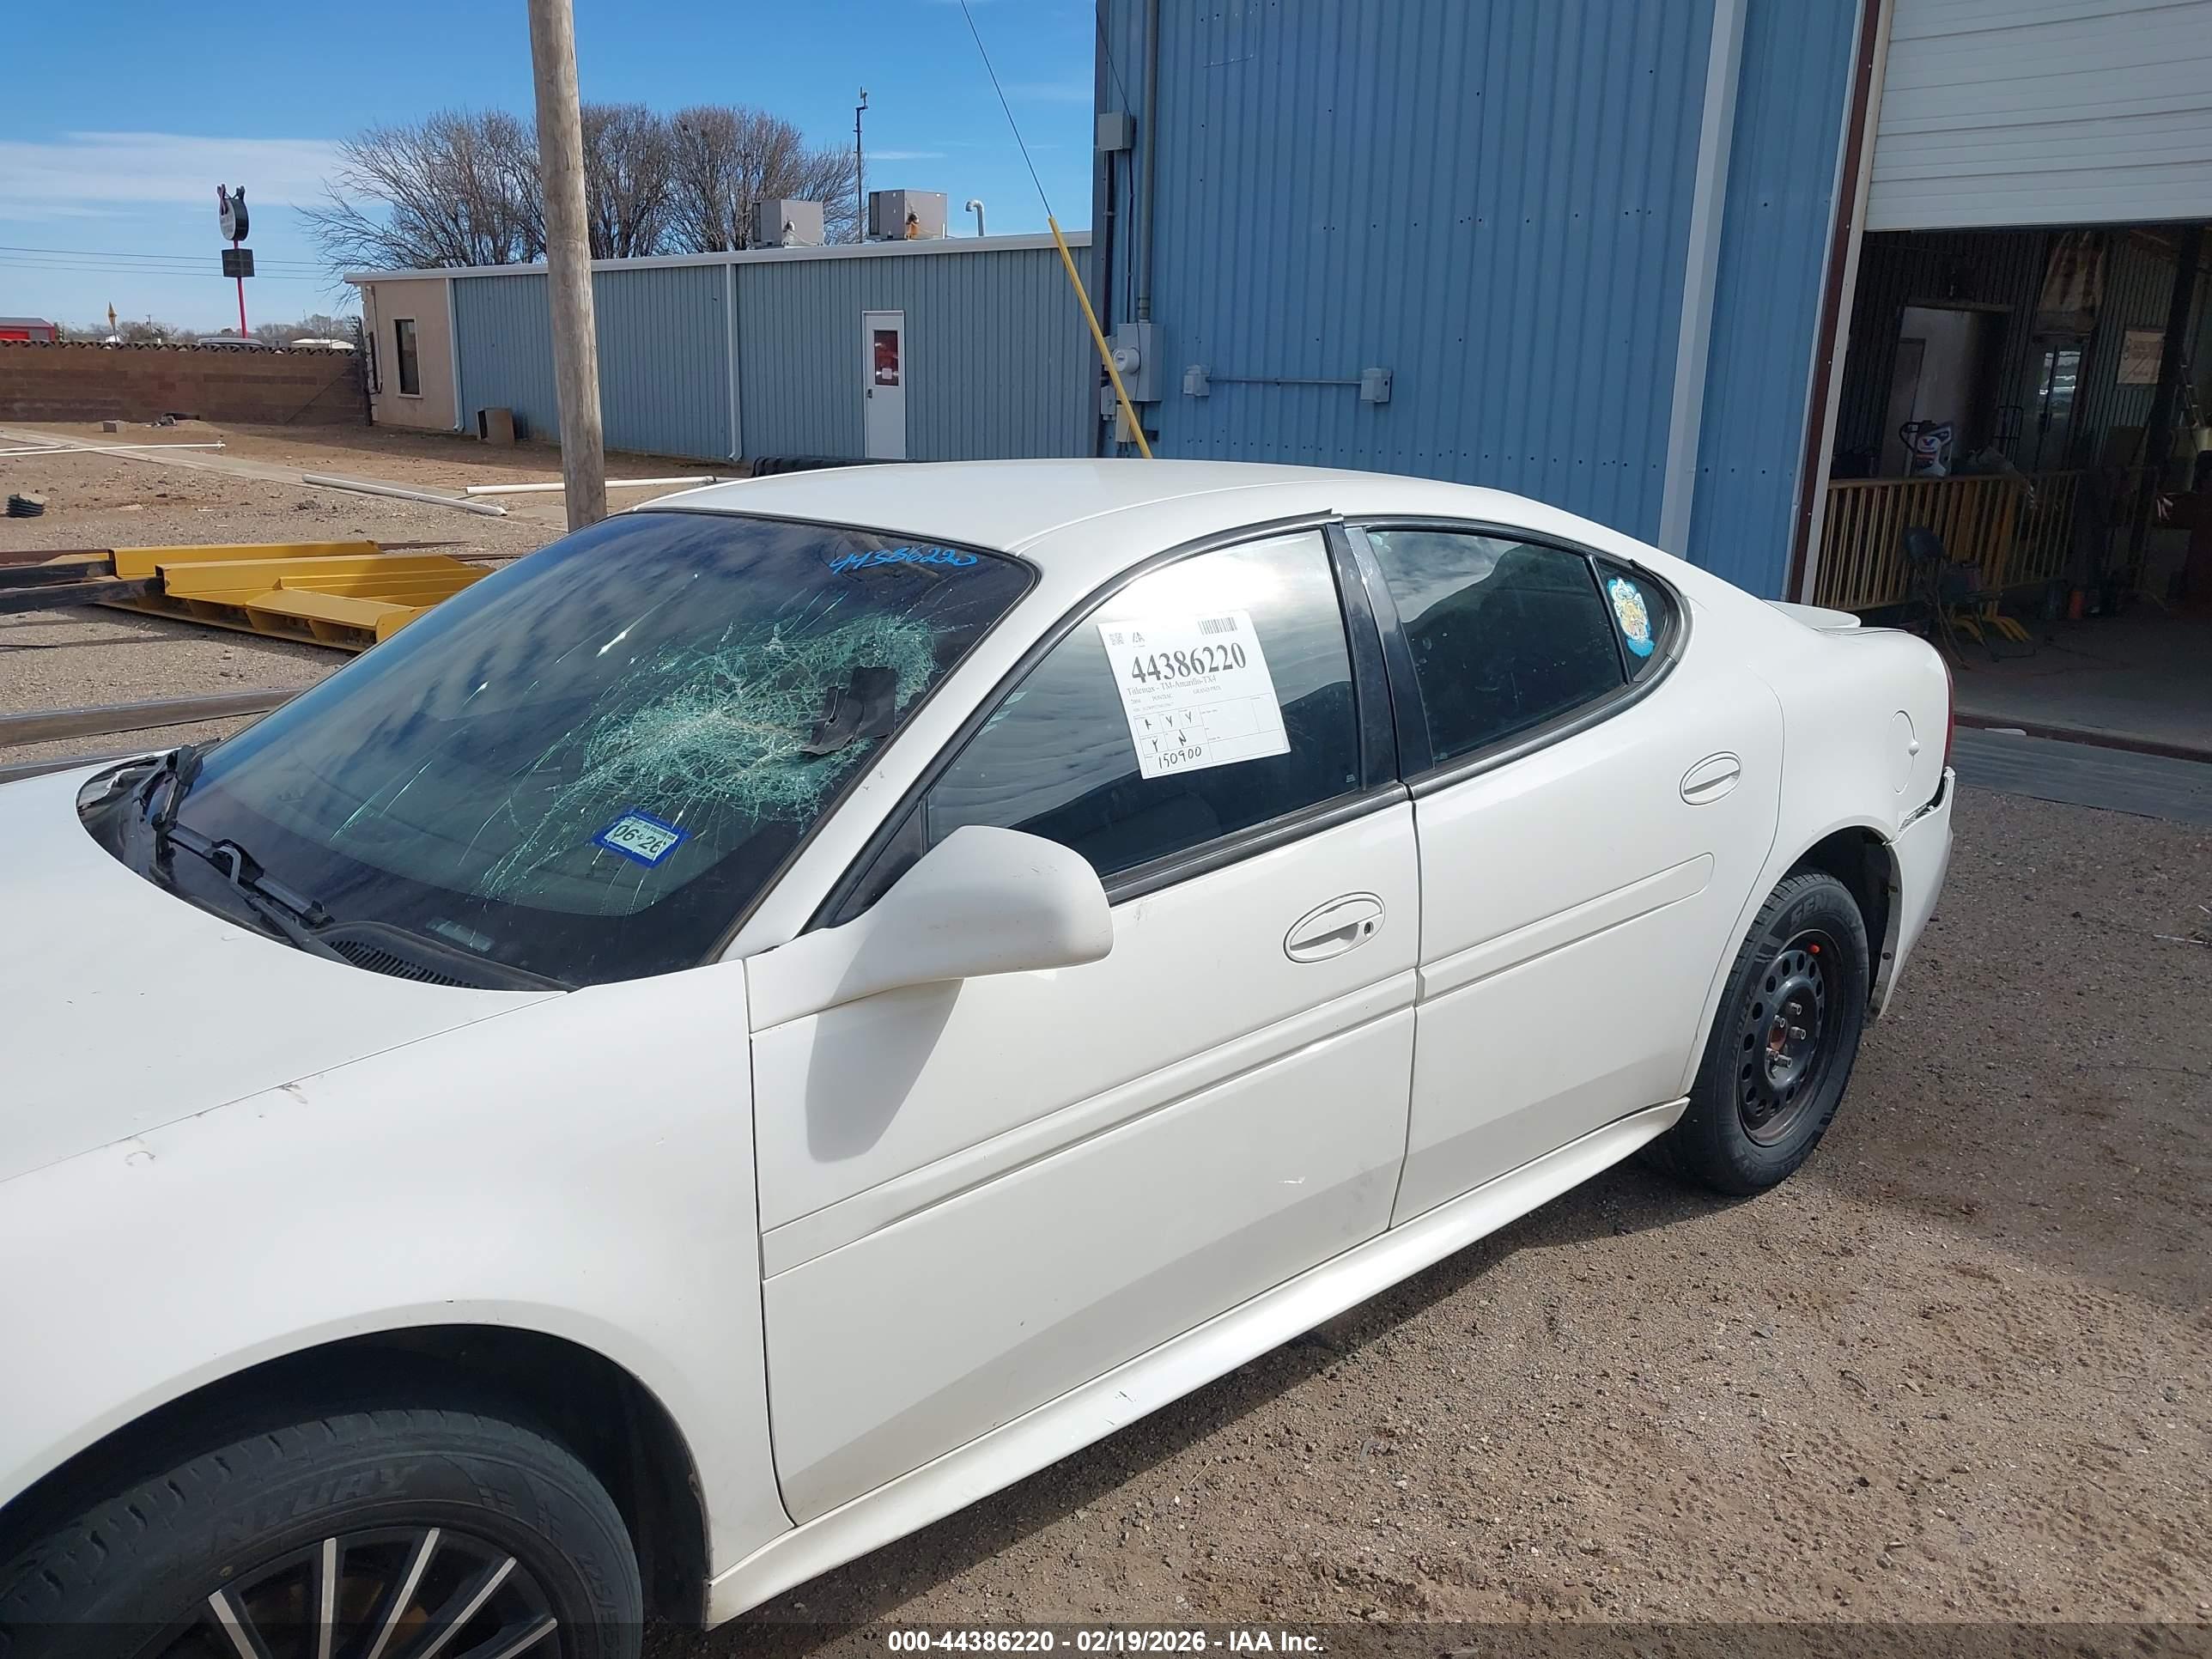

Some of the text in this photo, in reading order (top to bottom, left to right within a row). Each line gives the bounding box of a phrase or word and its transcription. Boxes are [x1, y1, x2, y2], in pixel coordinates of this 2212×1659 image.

[830, 544, 979, 575] 44386220
[1132, 642, 1247, 684] 44386220
[1127, 685, 1156, 696] Titlemax
[1165, 715, 1173, 727] Y
[1185, 711, 1193, 724] Y
[1152, 738, 1158, 752] Y
[1158, 746, 1202, 769] 150900
